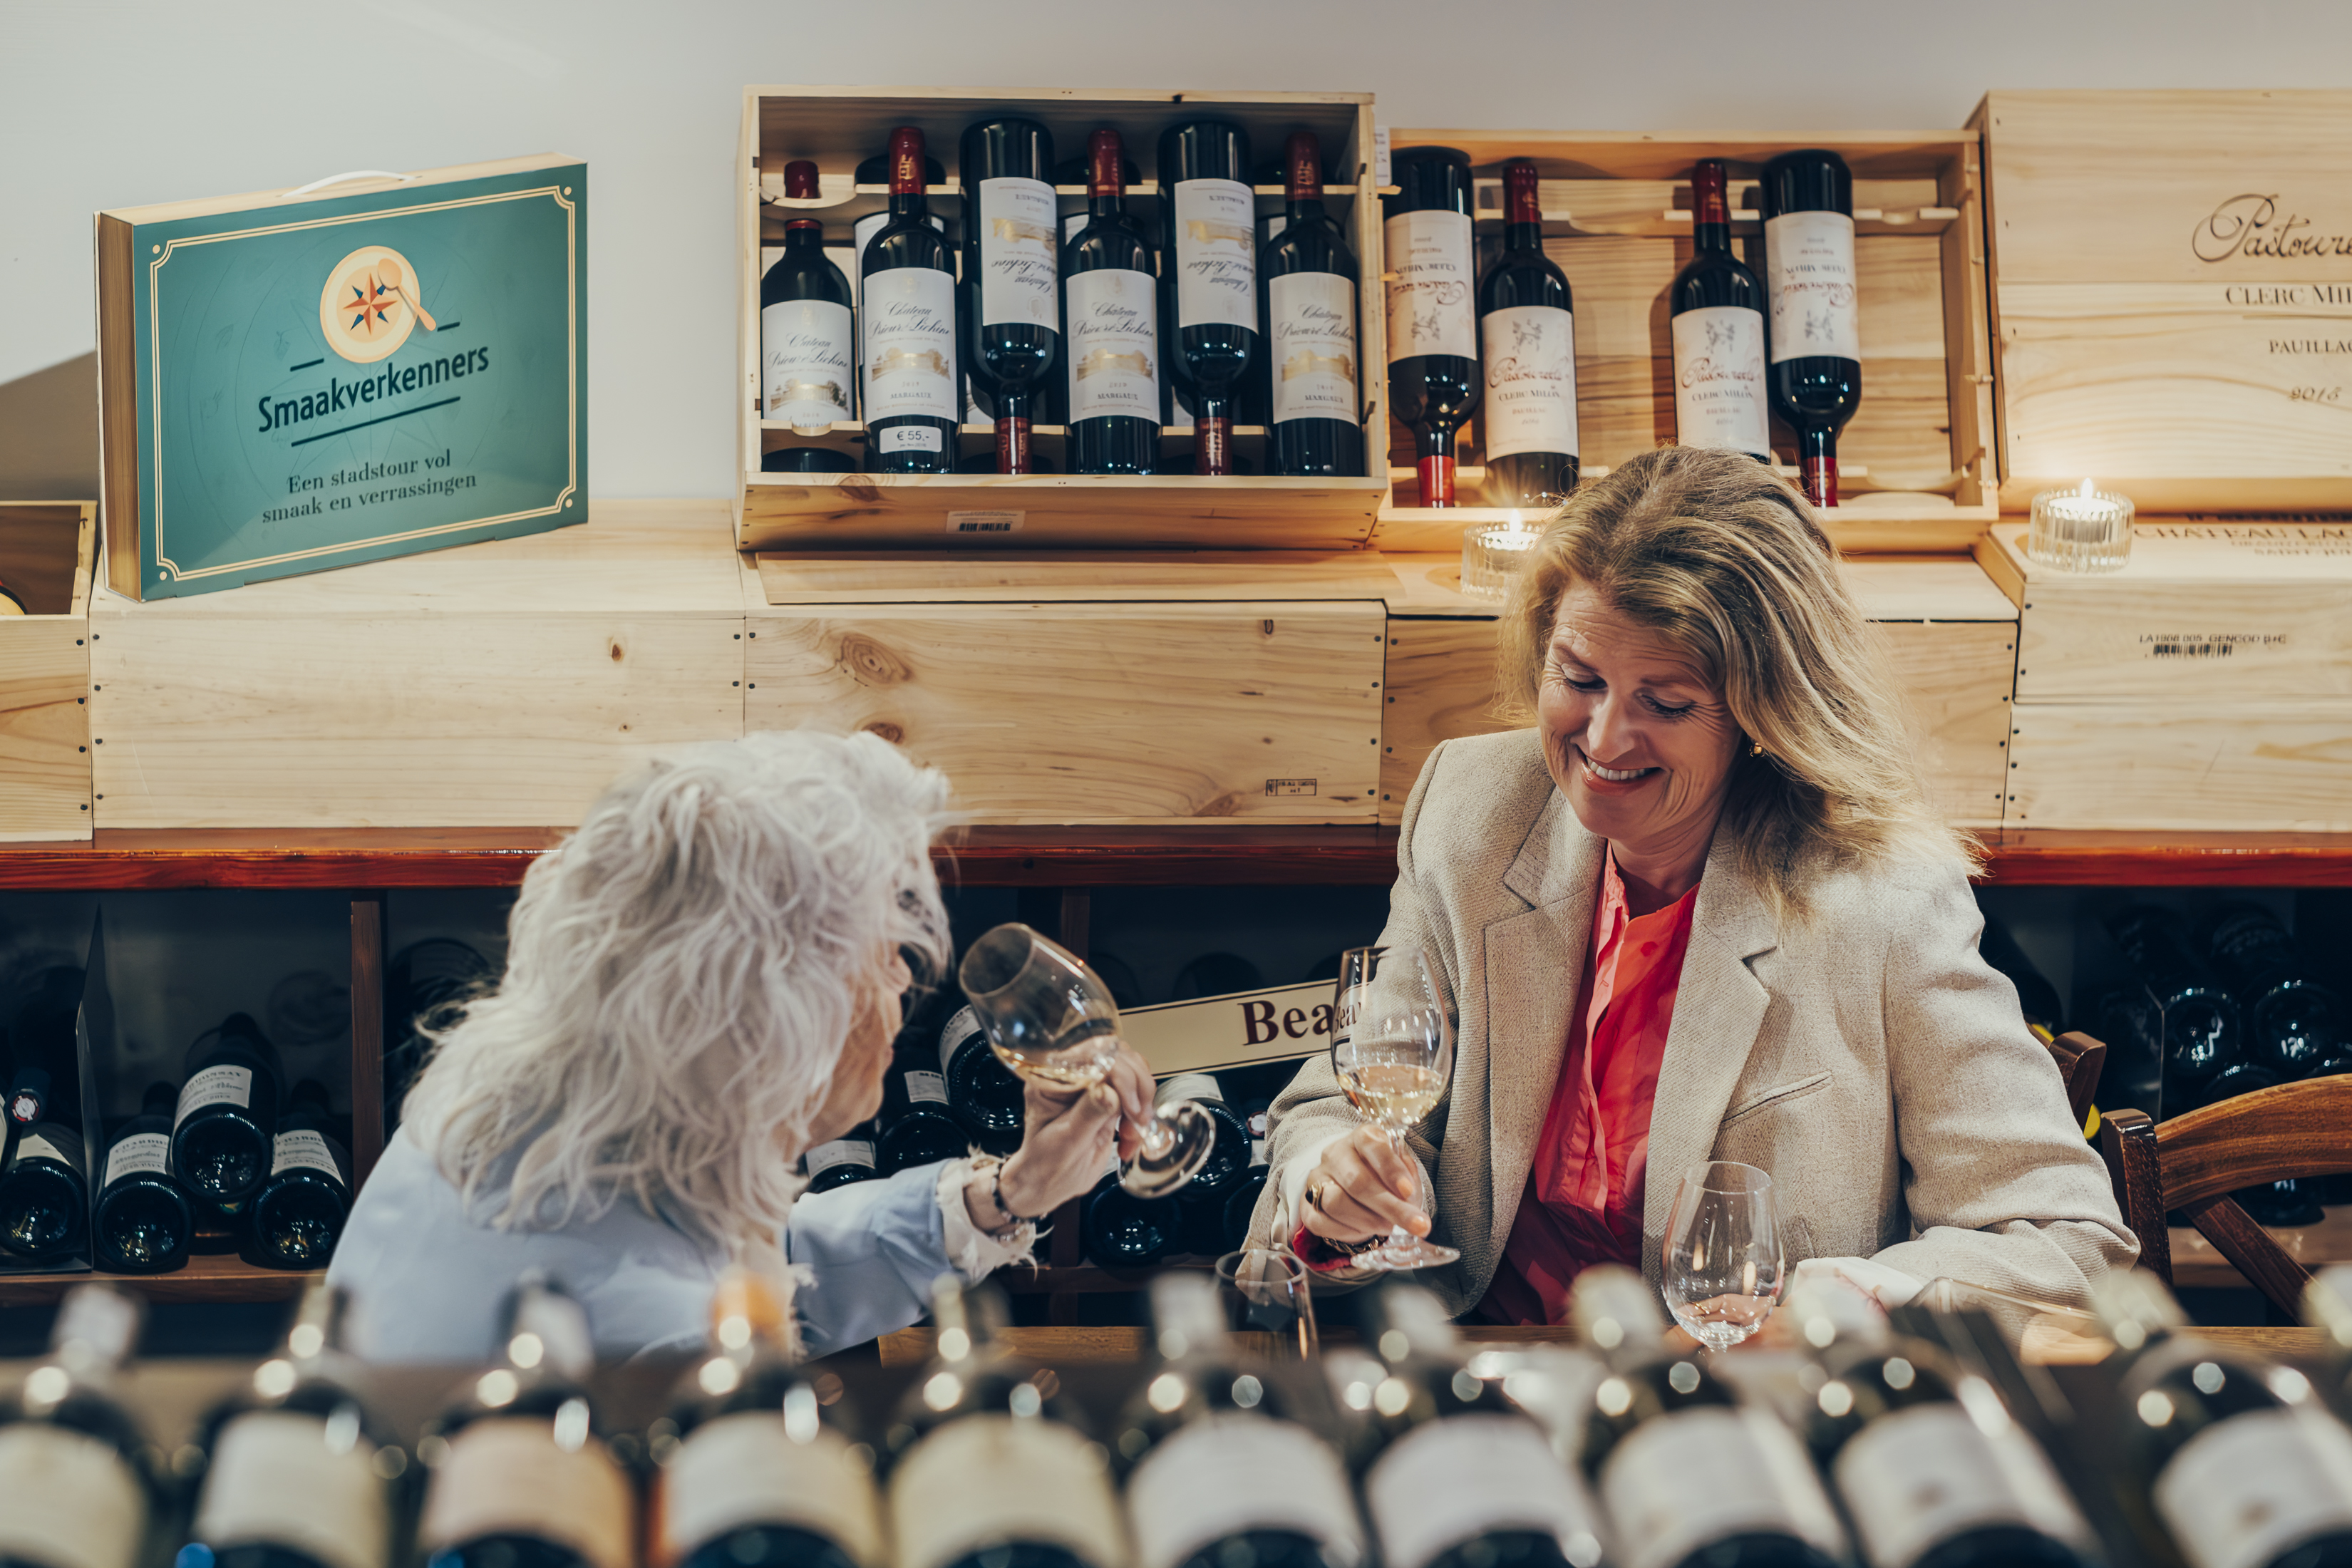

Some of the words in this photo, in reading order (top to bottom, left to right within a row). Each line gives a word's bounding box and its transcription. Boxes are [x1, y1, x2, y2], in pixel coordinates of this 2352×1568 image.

[2225, 286, 2305, 305] CLERC
[258, 346, 490, 433] Smaakverkenners
[288, 474, 324, 495] Een
[330, 461, 418, 488] stadstour
[424, 448, 451, 470] vol
[262, 496, 323, 524] smaak
[329, 495, 352, 512] en
[359, 475, 478, 507] verrassingen
